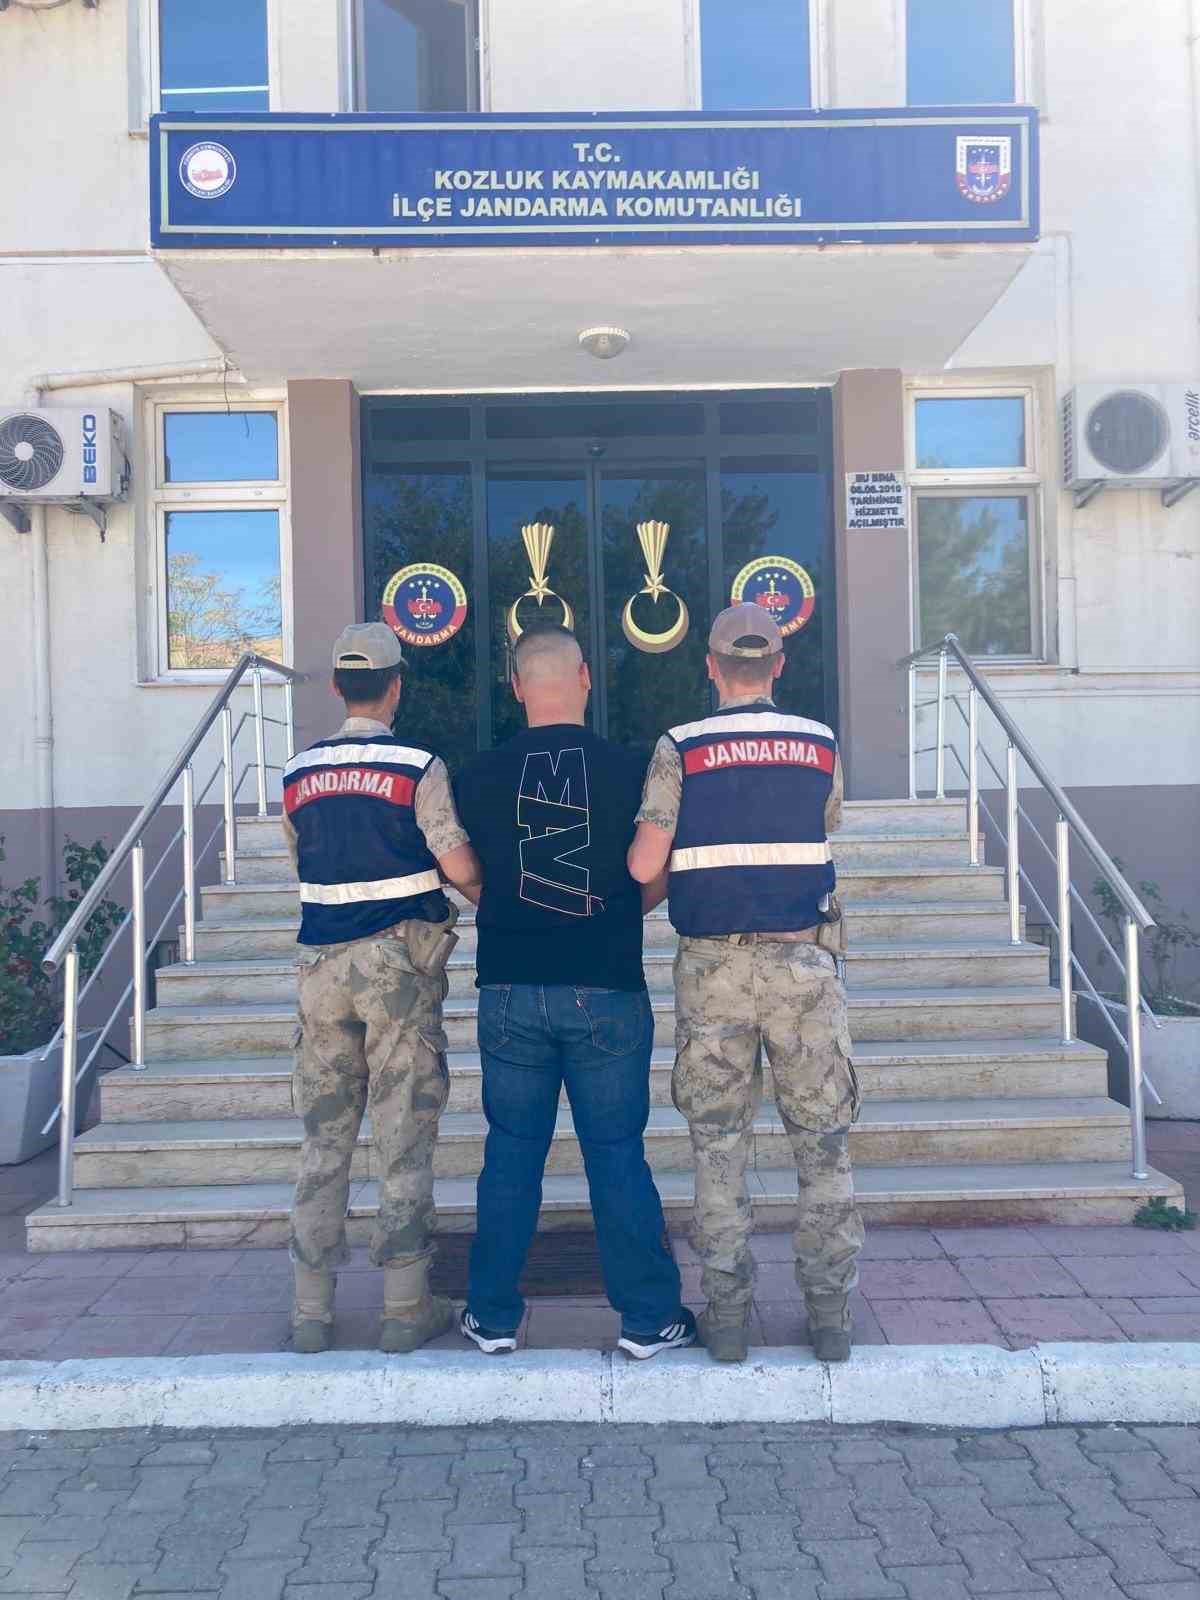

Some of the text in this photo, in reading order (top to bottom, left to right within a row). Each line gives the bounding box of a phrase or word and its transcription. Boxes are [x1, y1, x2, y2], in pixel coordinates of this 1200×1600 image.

[573, 143, 621, 162] T.C.
[434, 166, 760, 190] KOZLUK KAYMAKAMLIĞI
[392, 193, 802, 222] İLÇE JANDARMA KOMUTANLIĞI
[83, 414, 97, 484] BEKO
[393, 623, 457, 645] JANDARMA
[702, 740, 819, 767] JANDARMA
